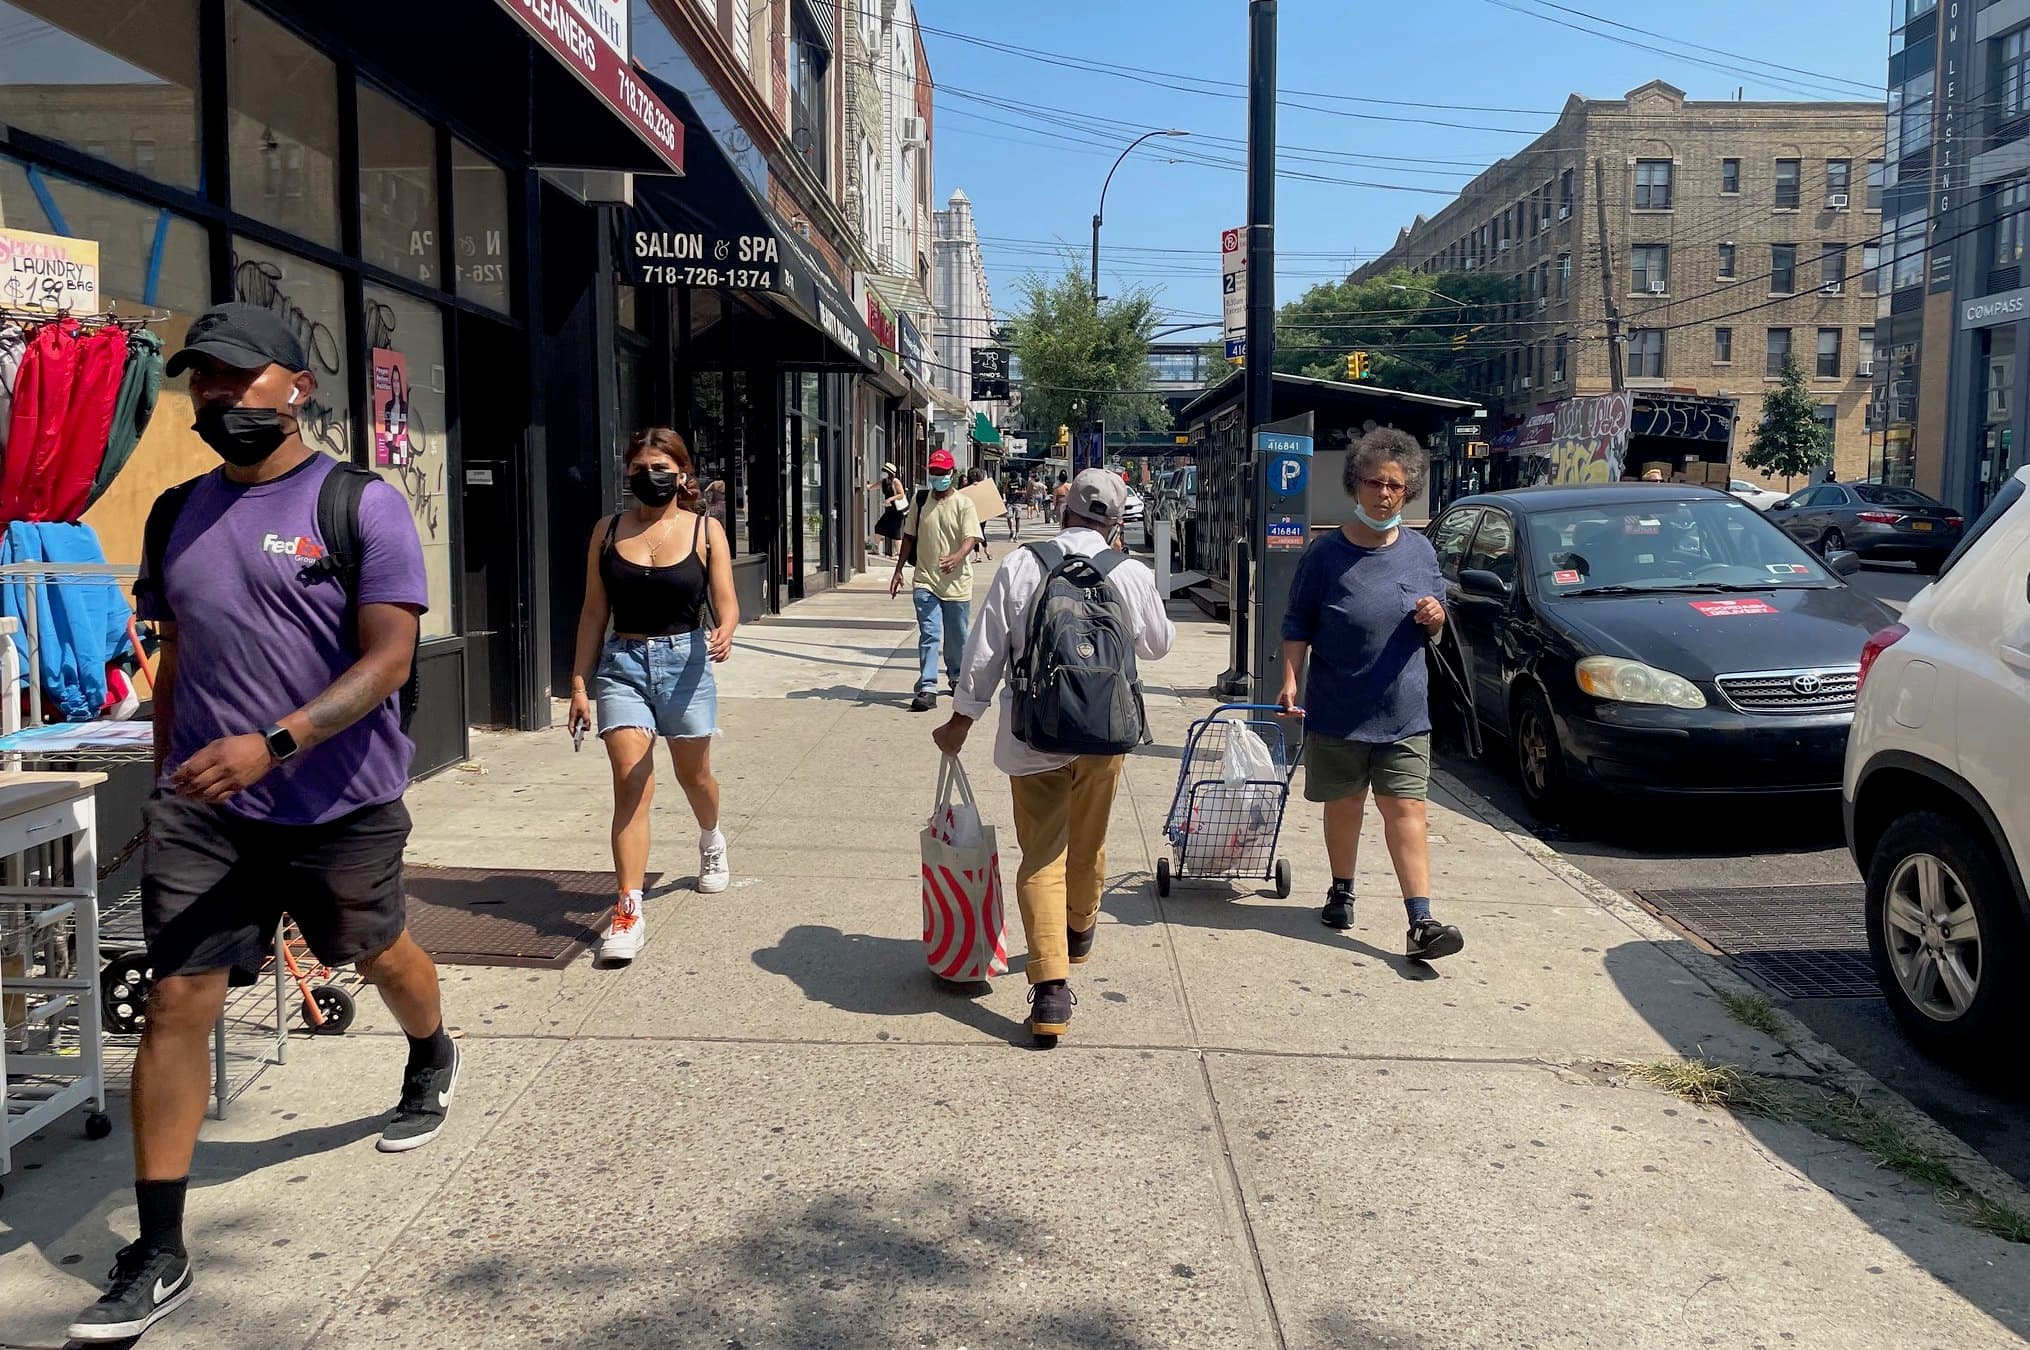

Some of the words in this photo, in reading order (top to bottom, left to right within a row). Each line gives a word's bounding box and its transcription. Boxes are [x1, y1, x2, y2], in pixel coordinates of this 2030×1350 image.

[523, 0, 596, 72] LEANERS
[618, 68, 675, 150] 718.726.2336
[1941, 60, 1955, 212] LEASING
[635, 231, 703, 259] SALON
[714, 239, 730, 261] &
[739, 235, 779, 263] SPA
[13, 256, 83, 280] LAUNDRY
[642, 265, 771, 289] 718-726-1374
[66, 280, 94, 292] BAG
[1966, 297, 2024, 321] COMPASS
[1267, 441, 1299, 451] 416841
[1271, 526, 1300, 536] 416841
